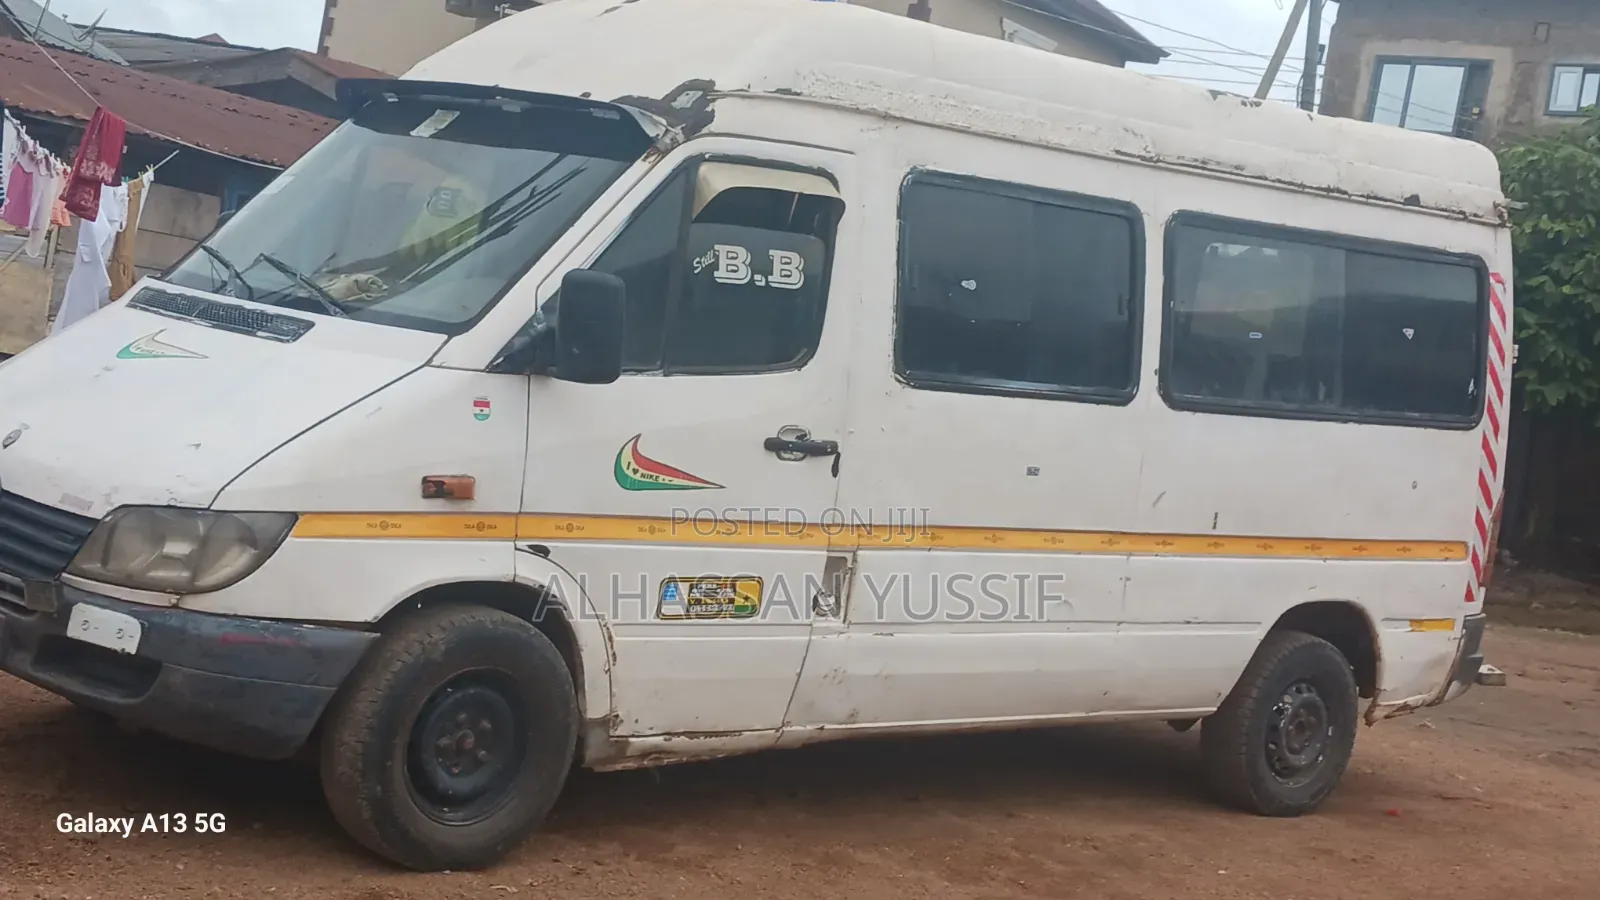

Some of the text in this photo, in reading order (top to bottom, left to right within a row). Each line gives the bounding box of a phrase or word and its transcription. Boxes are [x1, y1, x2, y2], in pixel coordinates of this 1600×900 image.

[692, 244, 805, 290] Still B.B
[626, 461, 660, 482] I NIKE
